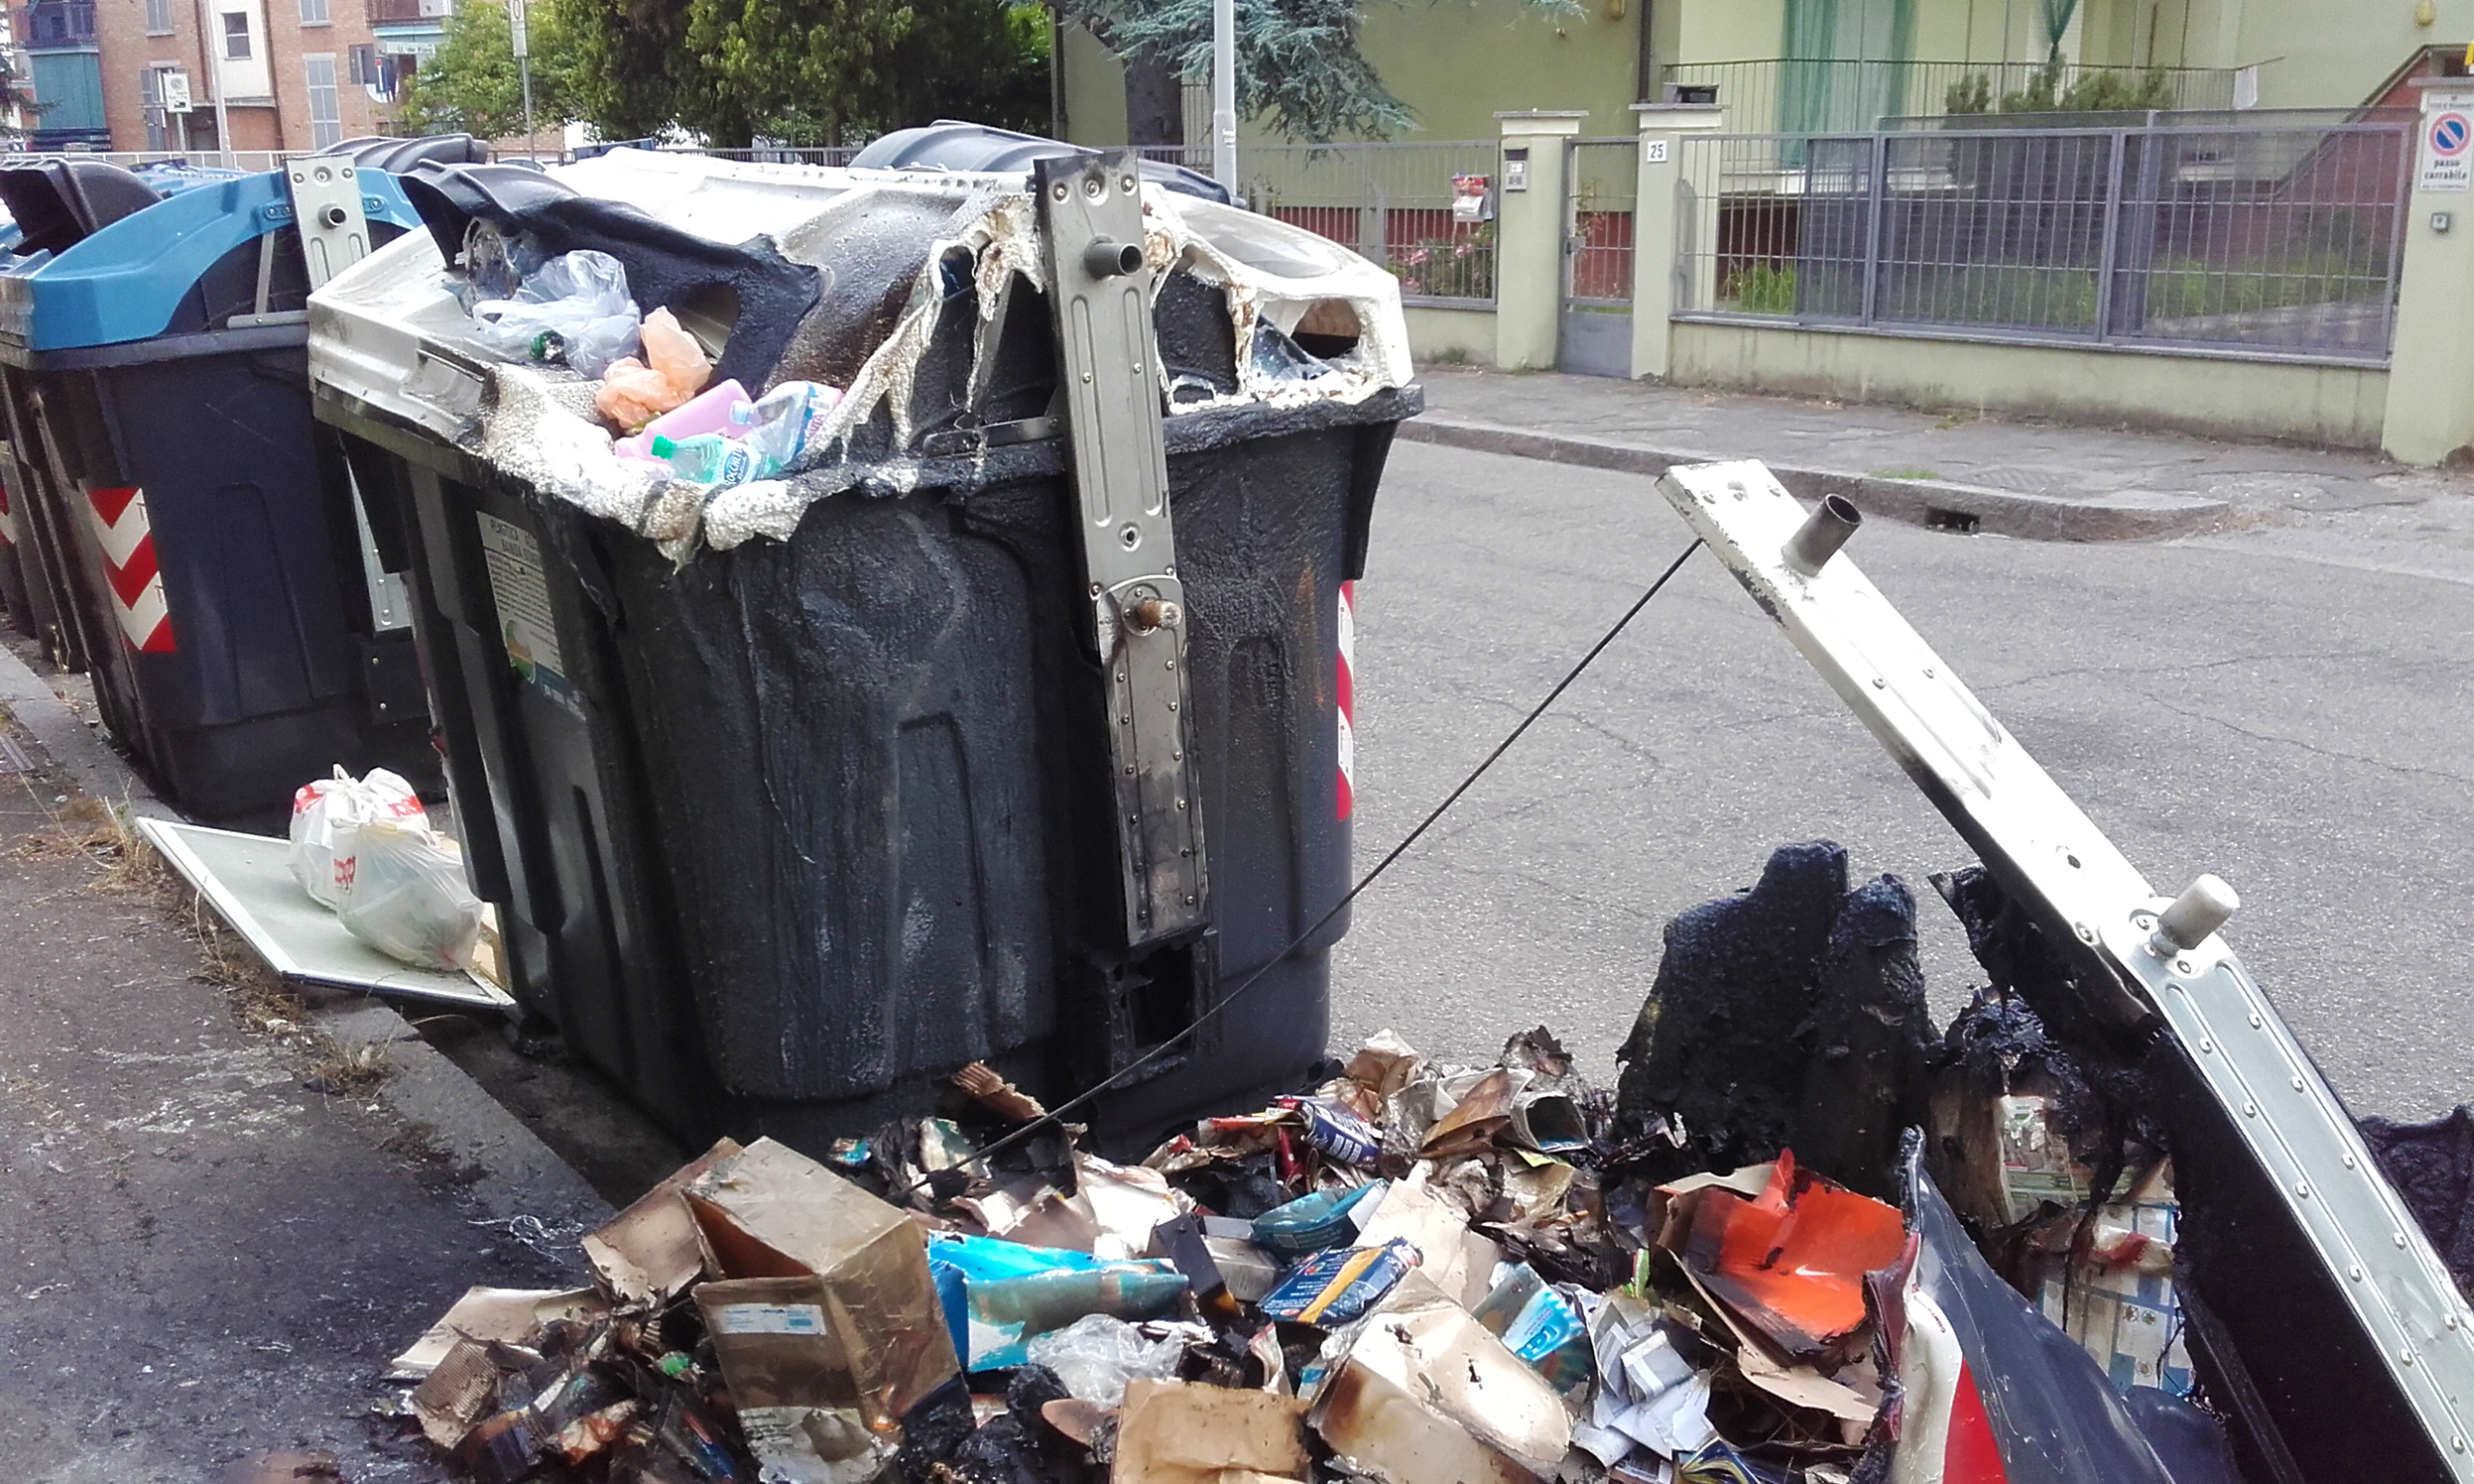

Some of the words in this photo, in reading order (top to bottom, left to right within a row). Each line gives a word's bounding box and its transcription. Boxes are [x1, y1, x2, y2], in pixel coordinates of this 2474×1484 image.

[1651, 144, 1663, 158] 25
[2433, 158, 2460, 169] passo
[2424, 170, 2467, 180] carrabile
